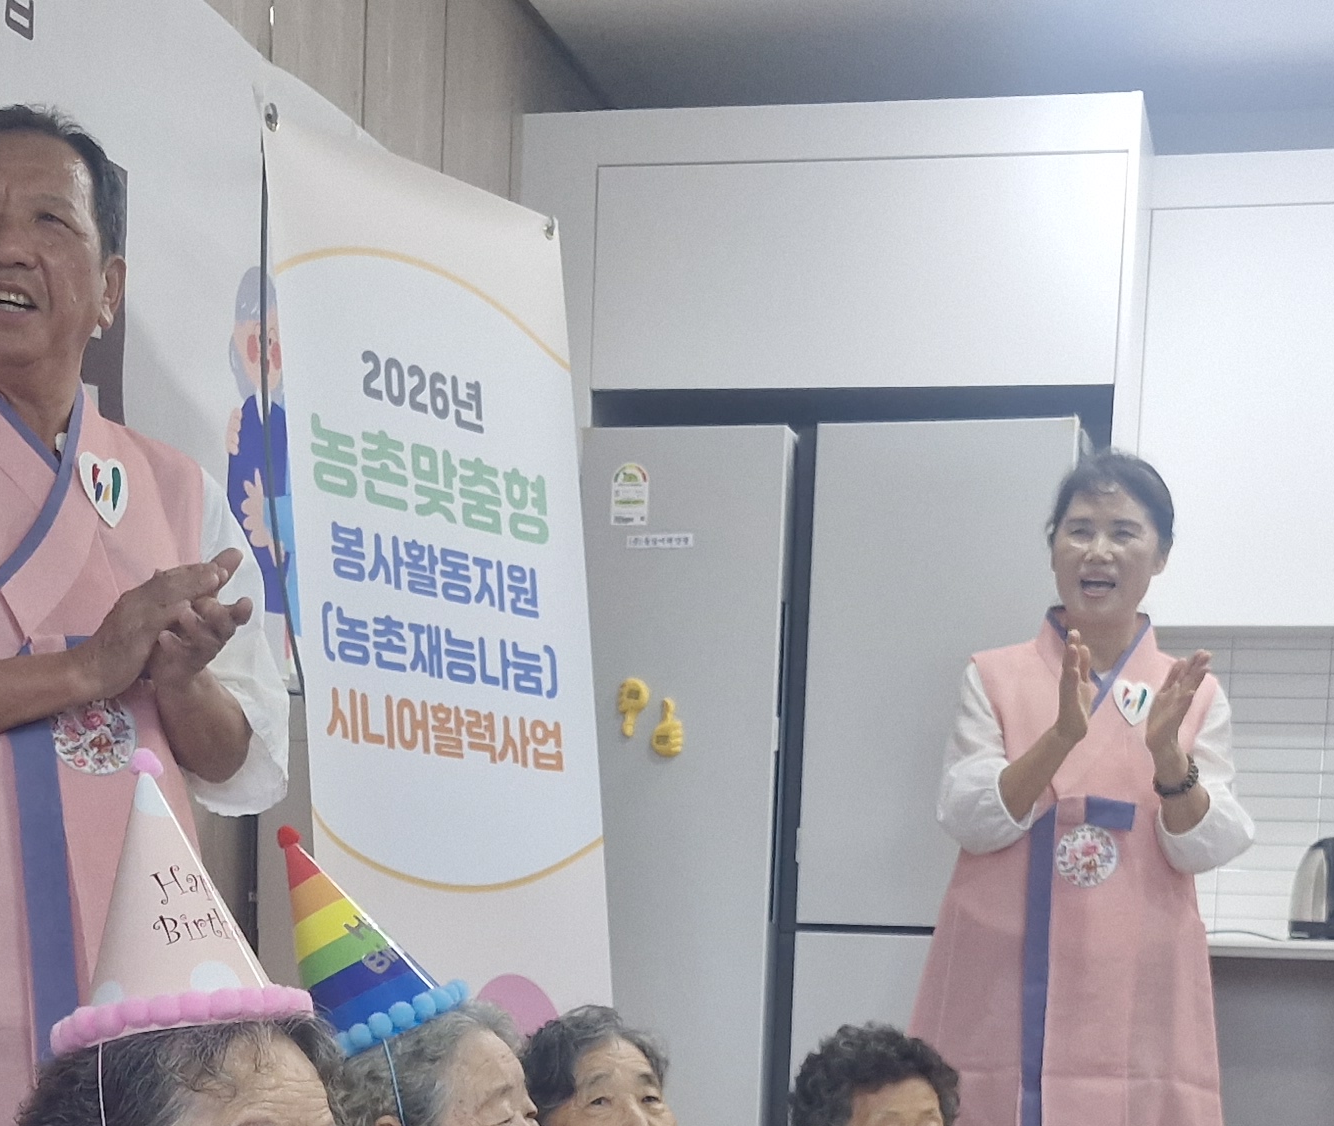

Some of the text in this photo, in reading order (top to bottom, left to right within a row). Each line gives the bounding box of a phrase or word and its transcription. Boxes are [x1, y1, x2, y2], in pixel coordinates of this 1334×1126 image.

[361, 350, 484, 434] 2026년
[310, 412, 550, 545] 농촌맞춤형
[331, 521, 540, 619] 봉사활동지원
[321, 601, 558, 699] (농촌재능나눔)
[326, 687, 564, 772] 시니어활력사업
